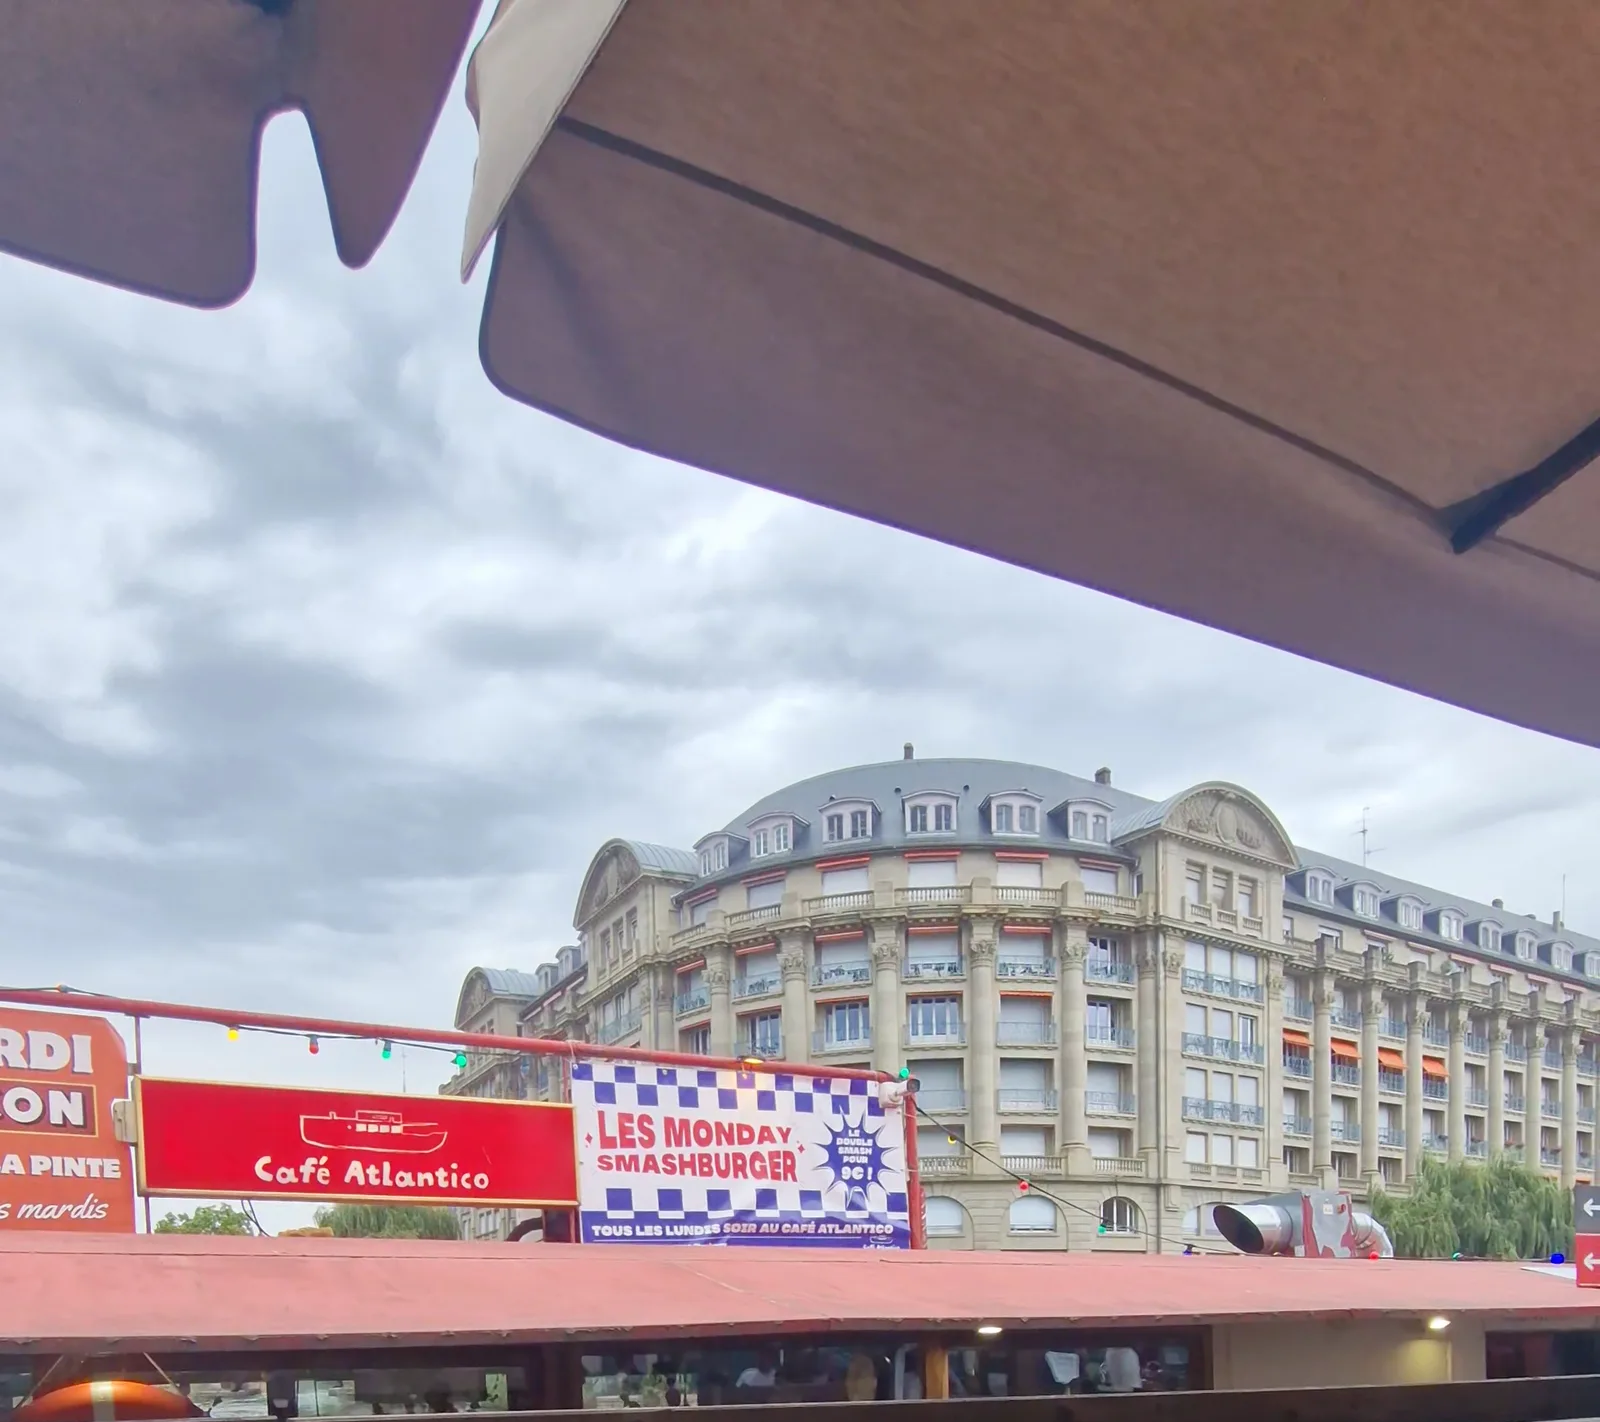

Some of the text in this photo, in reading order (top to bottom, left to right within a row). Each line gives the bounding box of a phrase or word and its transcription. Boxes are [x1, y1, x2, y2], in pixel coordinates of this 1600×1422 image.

[0, 1027, 94, 1074] RDI
[0, 1087, 85, 1127] ON
[597, 1110, 792, 1150] LES MONDAY
[836, 1138, 873, 1146] DOUBLE
[848, 1129, 860, 1137] LE
[838, 1146, 872, 1155] SMASH
[843, 1155, 868, 1164] POUR
[0, 1154, 121, 1179] A PINTE
[254, 1155, 490, 1190] Café Atlantico
[597, 1150, 798, 1183] SMASHBURGER
[17, 1193, 109, 1220] mardis
[591, 1221, 894, 1237] TOUS LES LUNDIS SOIR AU CAFÉ ATLANTICO
